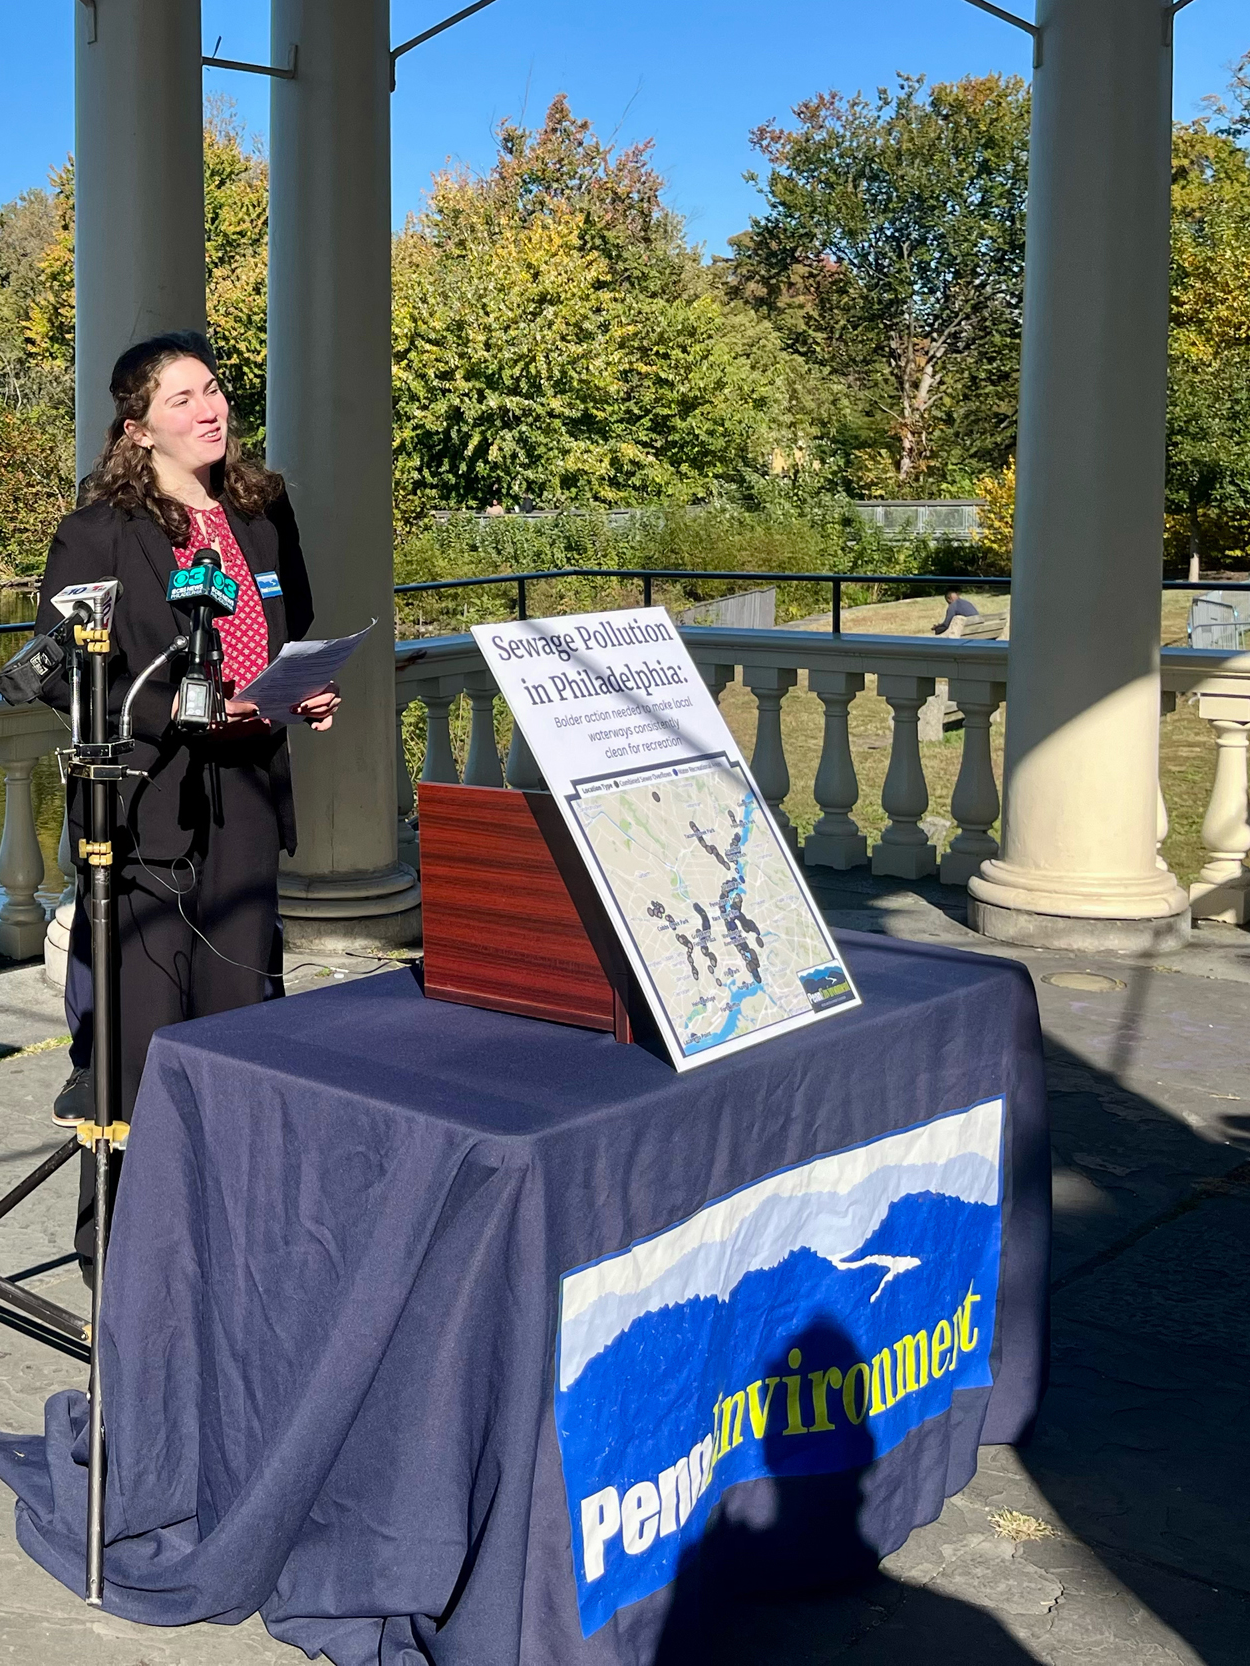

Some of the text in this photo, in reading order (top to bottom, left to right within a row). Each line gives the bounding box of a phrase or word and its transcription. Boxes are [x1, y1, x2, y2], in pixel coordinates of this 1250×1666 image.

[67, 587, 88, 596] 10
[491, 618, 674, 663] Sewage Pollution
[520, 659, 688, 706] in Philadelphia:
[554, 696, 693, 728] Bolder action needed to make local
[588, 717, 680, 743] waterways consistently
[604, 736, 683, 759] clean for recreation
[582, 784, 602, 795] Location
[601, 782, 614, 792] Type
